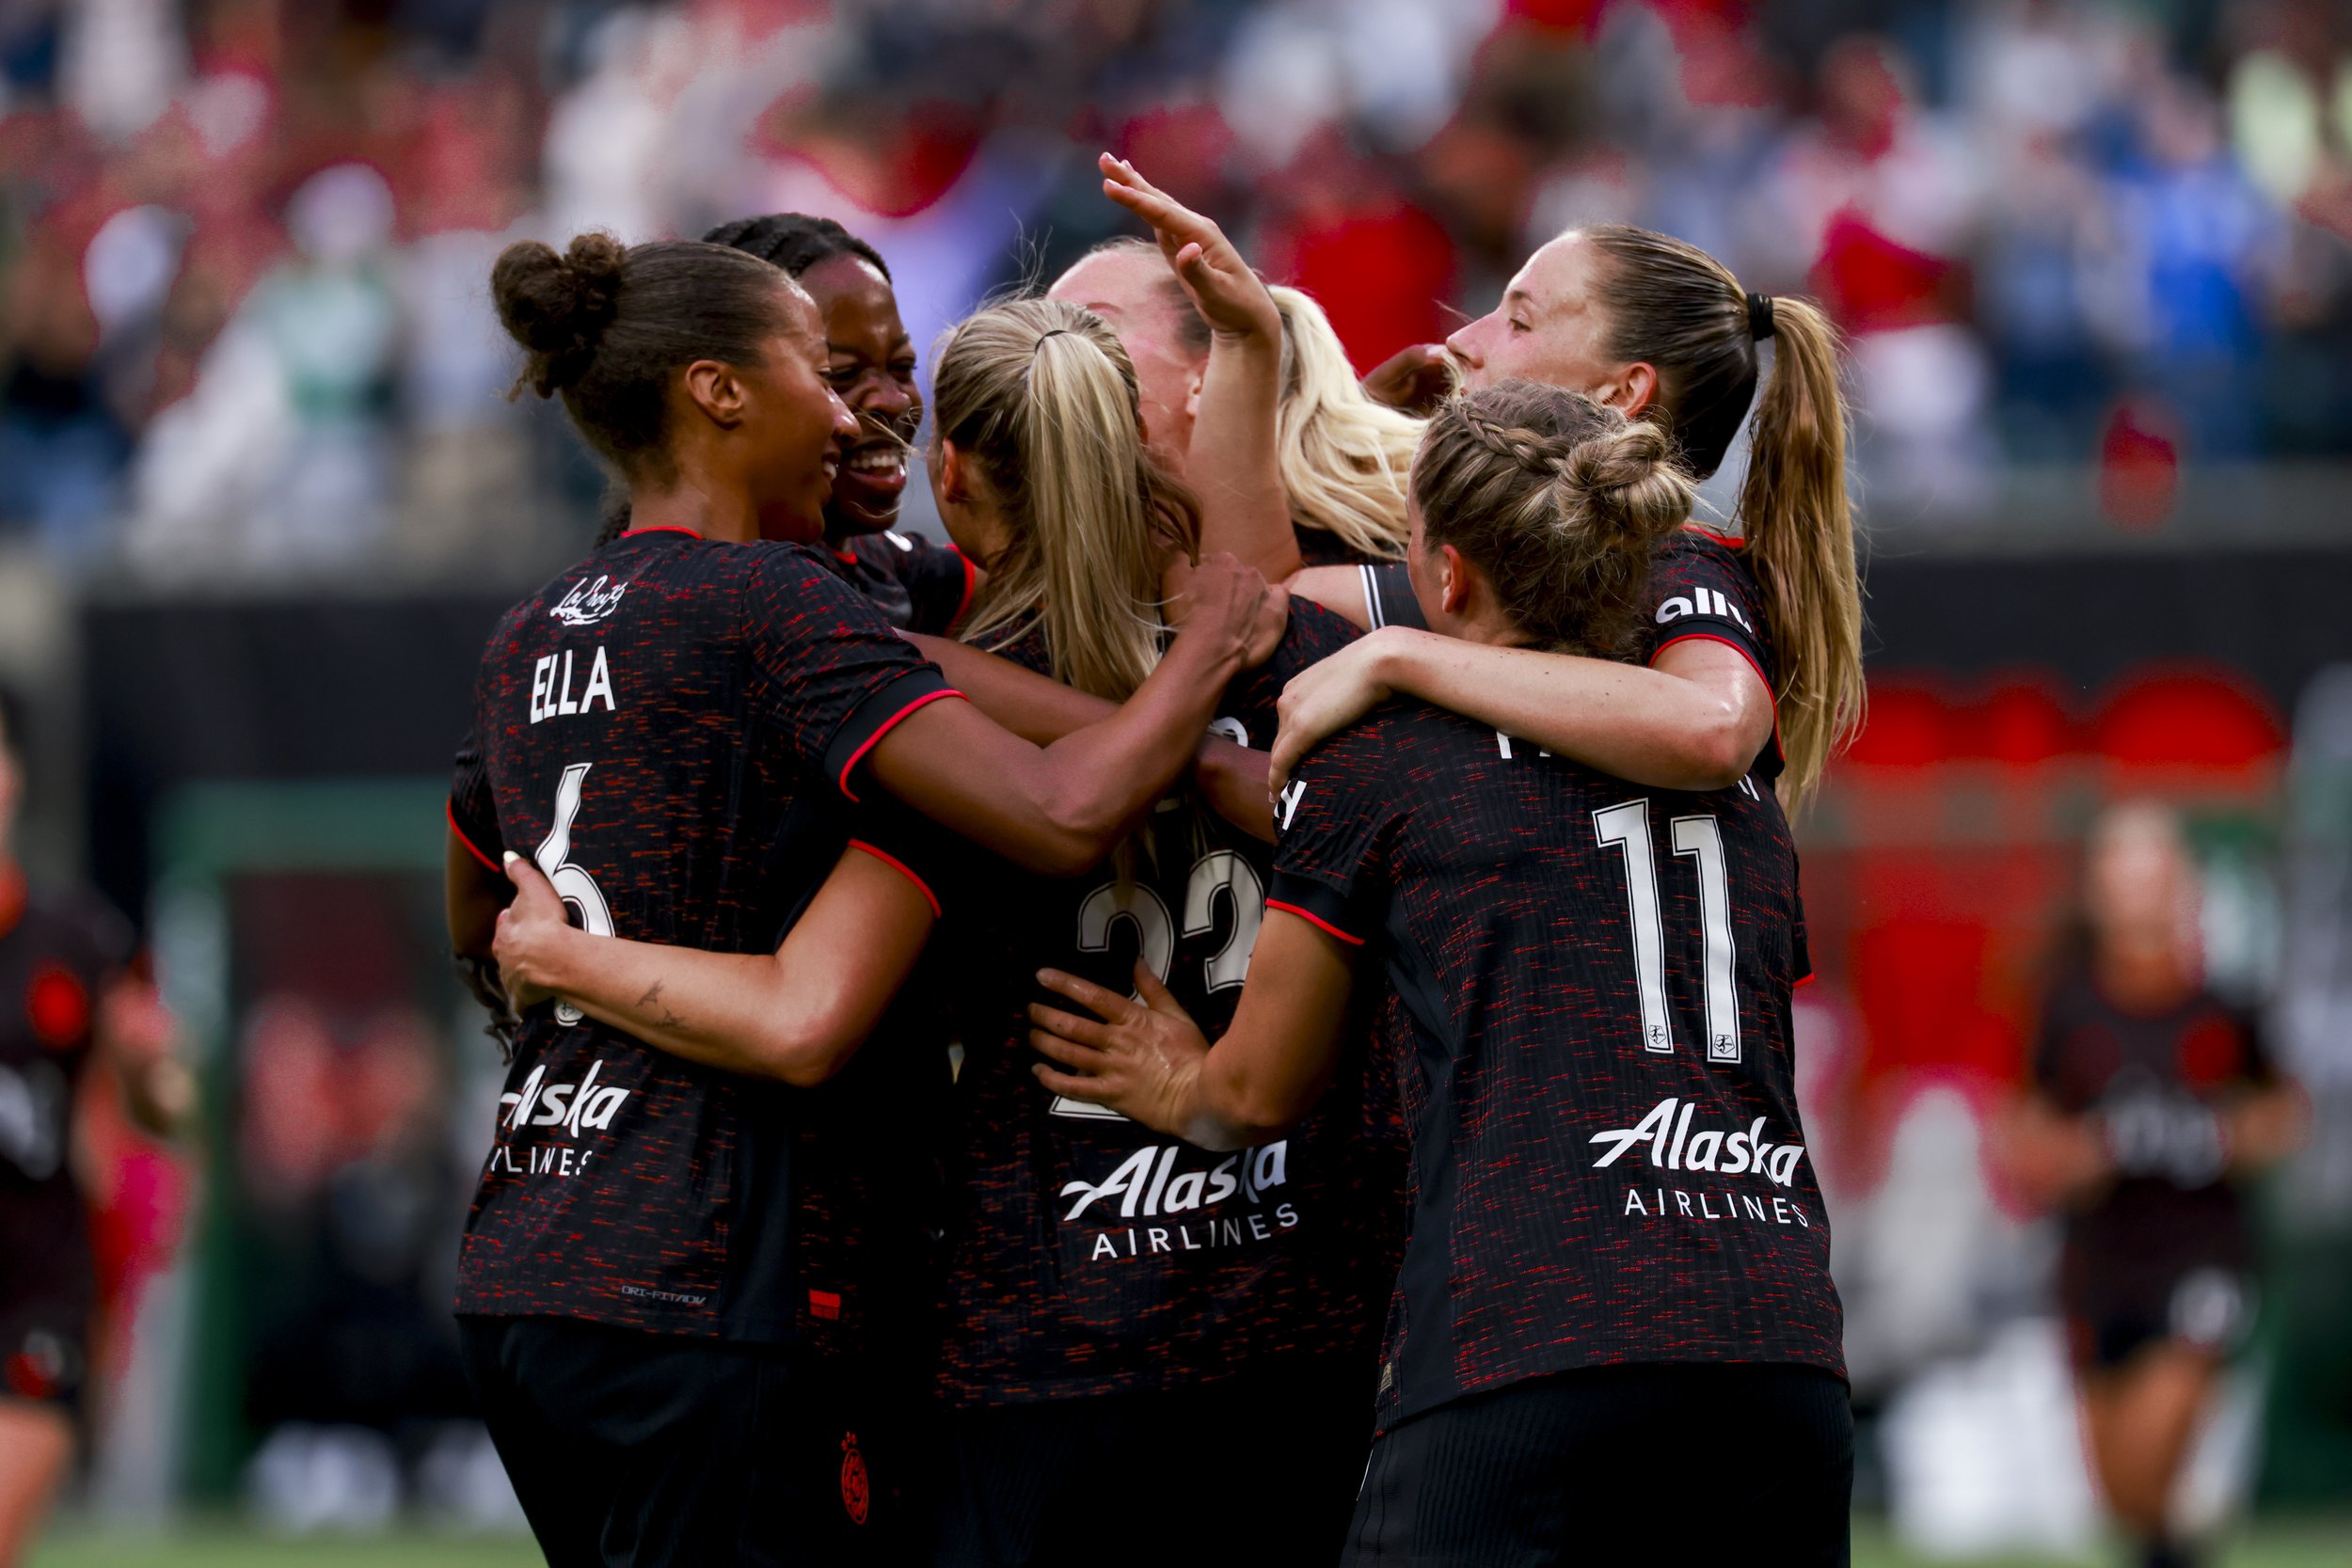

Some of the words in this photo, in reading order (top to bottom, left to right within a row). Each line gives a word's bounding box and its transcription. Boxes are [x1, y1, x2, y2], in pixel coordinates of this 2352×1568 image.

[530, 645, 616, 724] ELLA
[534, 762, 616, 1026] 6
[1592, 798, 1741, 1064] 11
[501, 1059, 631, 1138] Aska
[490, 1146, 593, 1176] LINES
[1059, 1139, 1288, 1221] Alaska
[1588, 1098, 1804, 1187] Alaska
[1091, 1203, 1299, 1261] AIRLINES
[1625, 1188, 1808, 1227] AIRLINES
